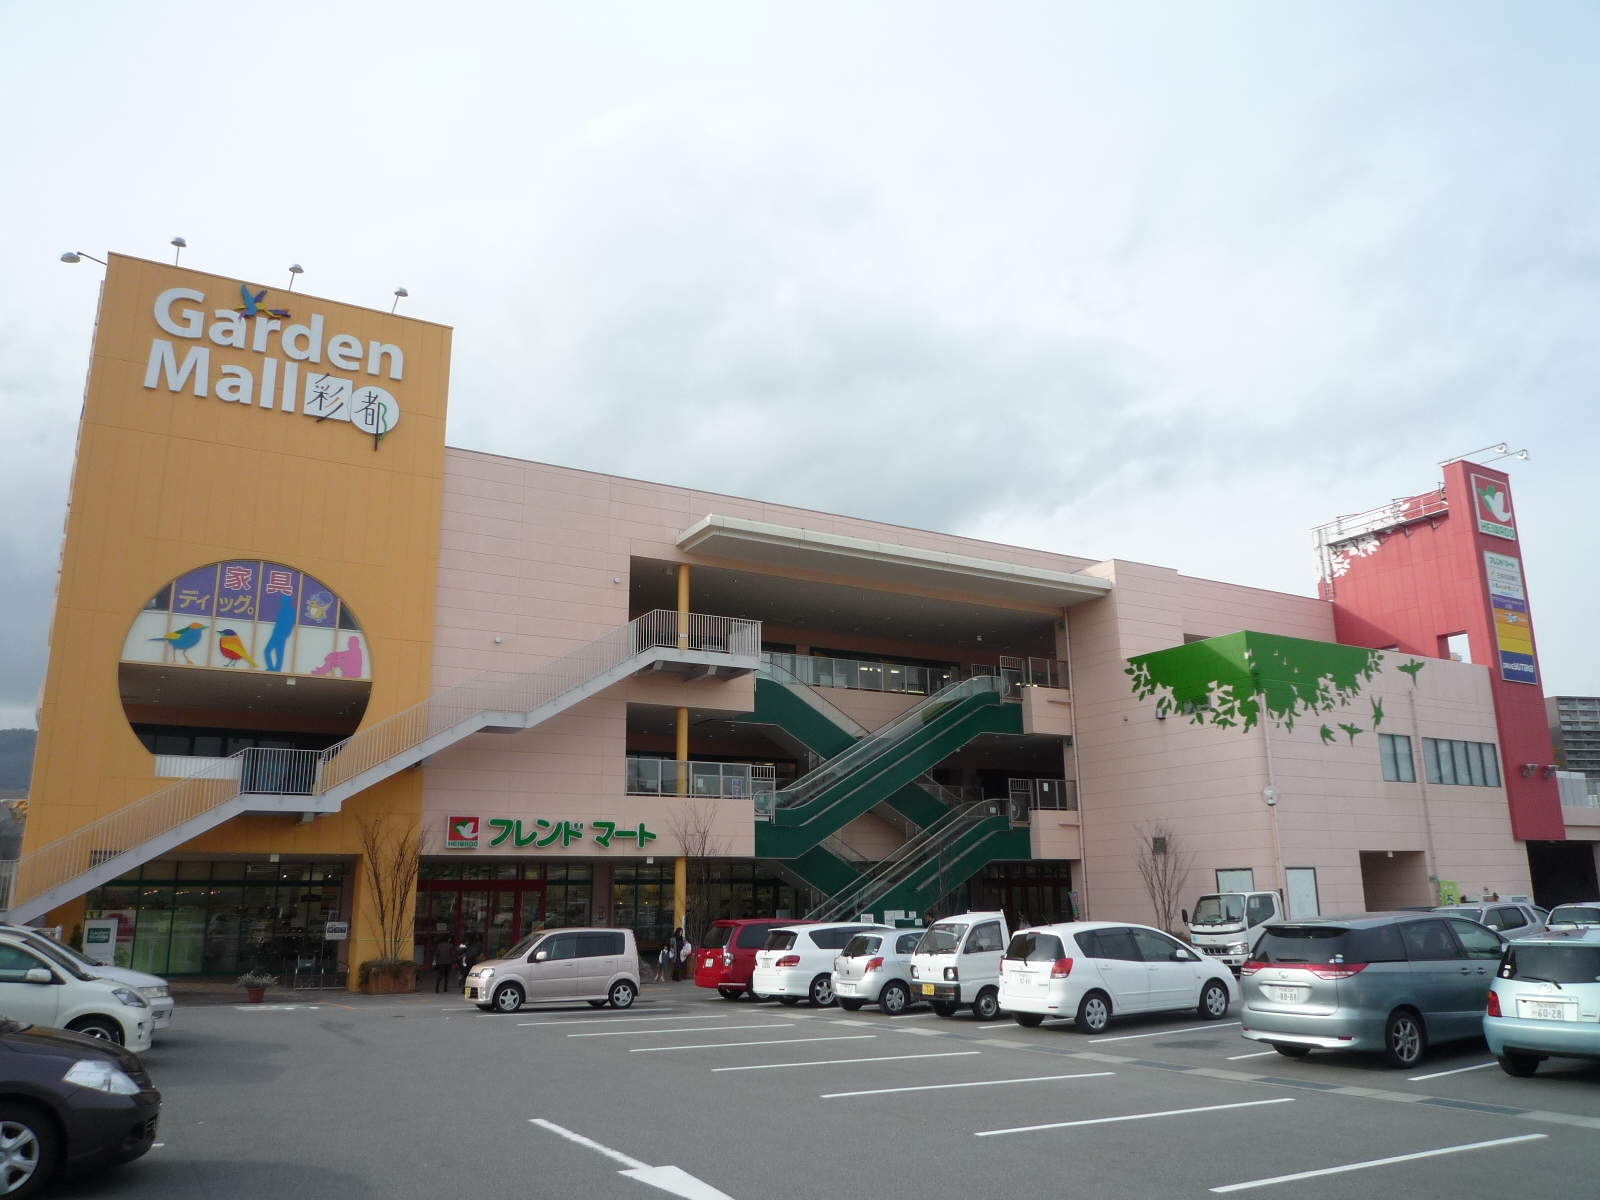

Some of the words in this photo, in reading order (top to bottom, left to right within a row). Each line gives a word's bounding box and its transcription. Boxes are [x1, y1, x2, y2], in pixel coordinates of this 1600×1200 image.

[153, 287, 404, 380] Garden
[143, 338, 299, 413] Mall
[224, 566, 293, 596] 家具
[447, 840, 479, 848] HEIWADO
[488, 817, 585, 848] フレンド
[592, 821, 658, 849] マート
[1537, 1008, 1562, 1019] 60-28
